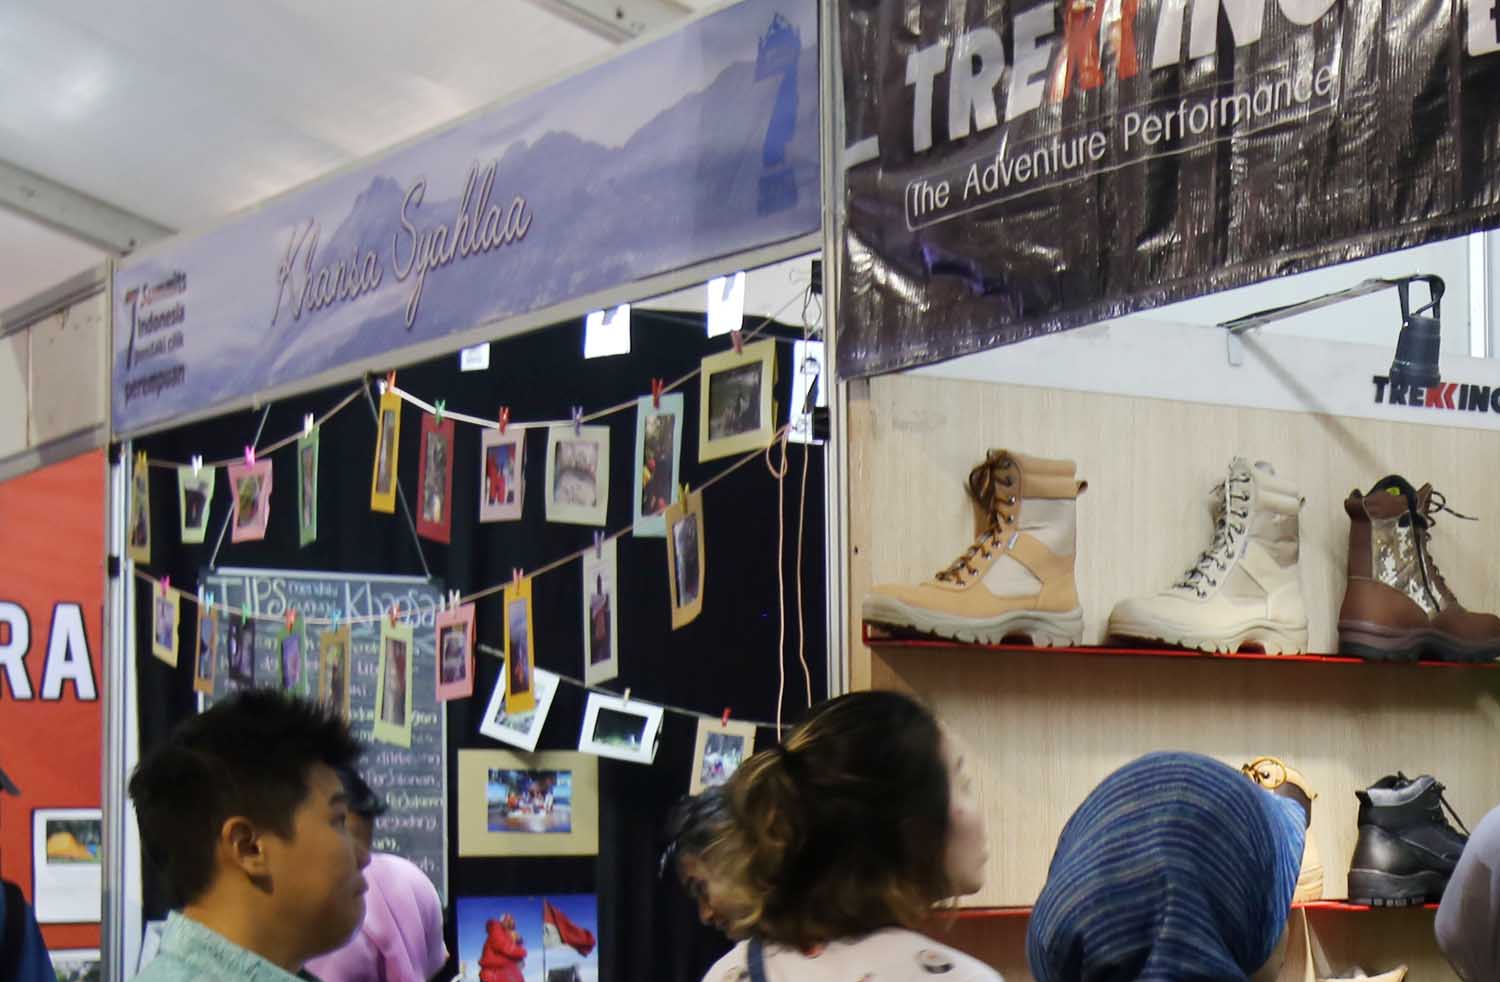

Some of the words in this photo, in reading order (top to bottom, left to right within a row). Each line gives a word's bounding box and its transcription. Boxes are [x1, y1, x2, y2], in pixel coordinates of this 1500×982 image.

[912, 181, 950, 217] The
[964, 131, 1106, 201] Adventure
[1124, 66, 1334, 152] Performance
[271, 216, 384, 328] Khansa
[392, 159, 533, 332] Syahlaa
